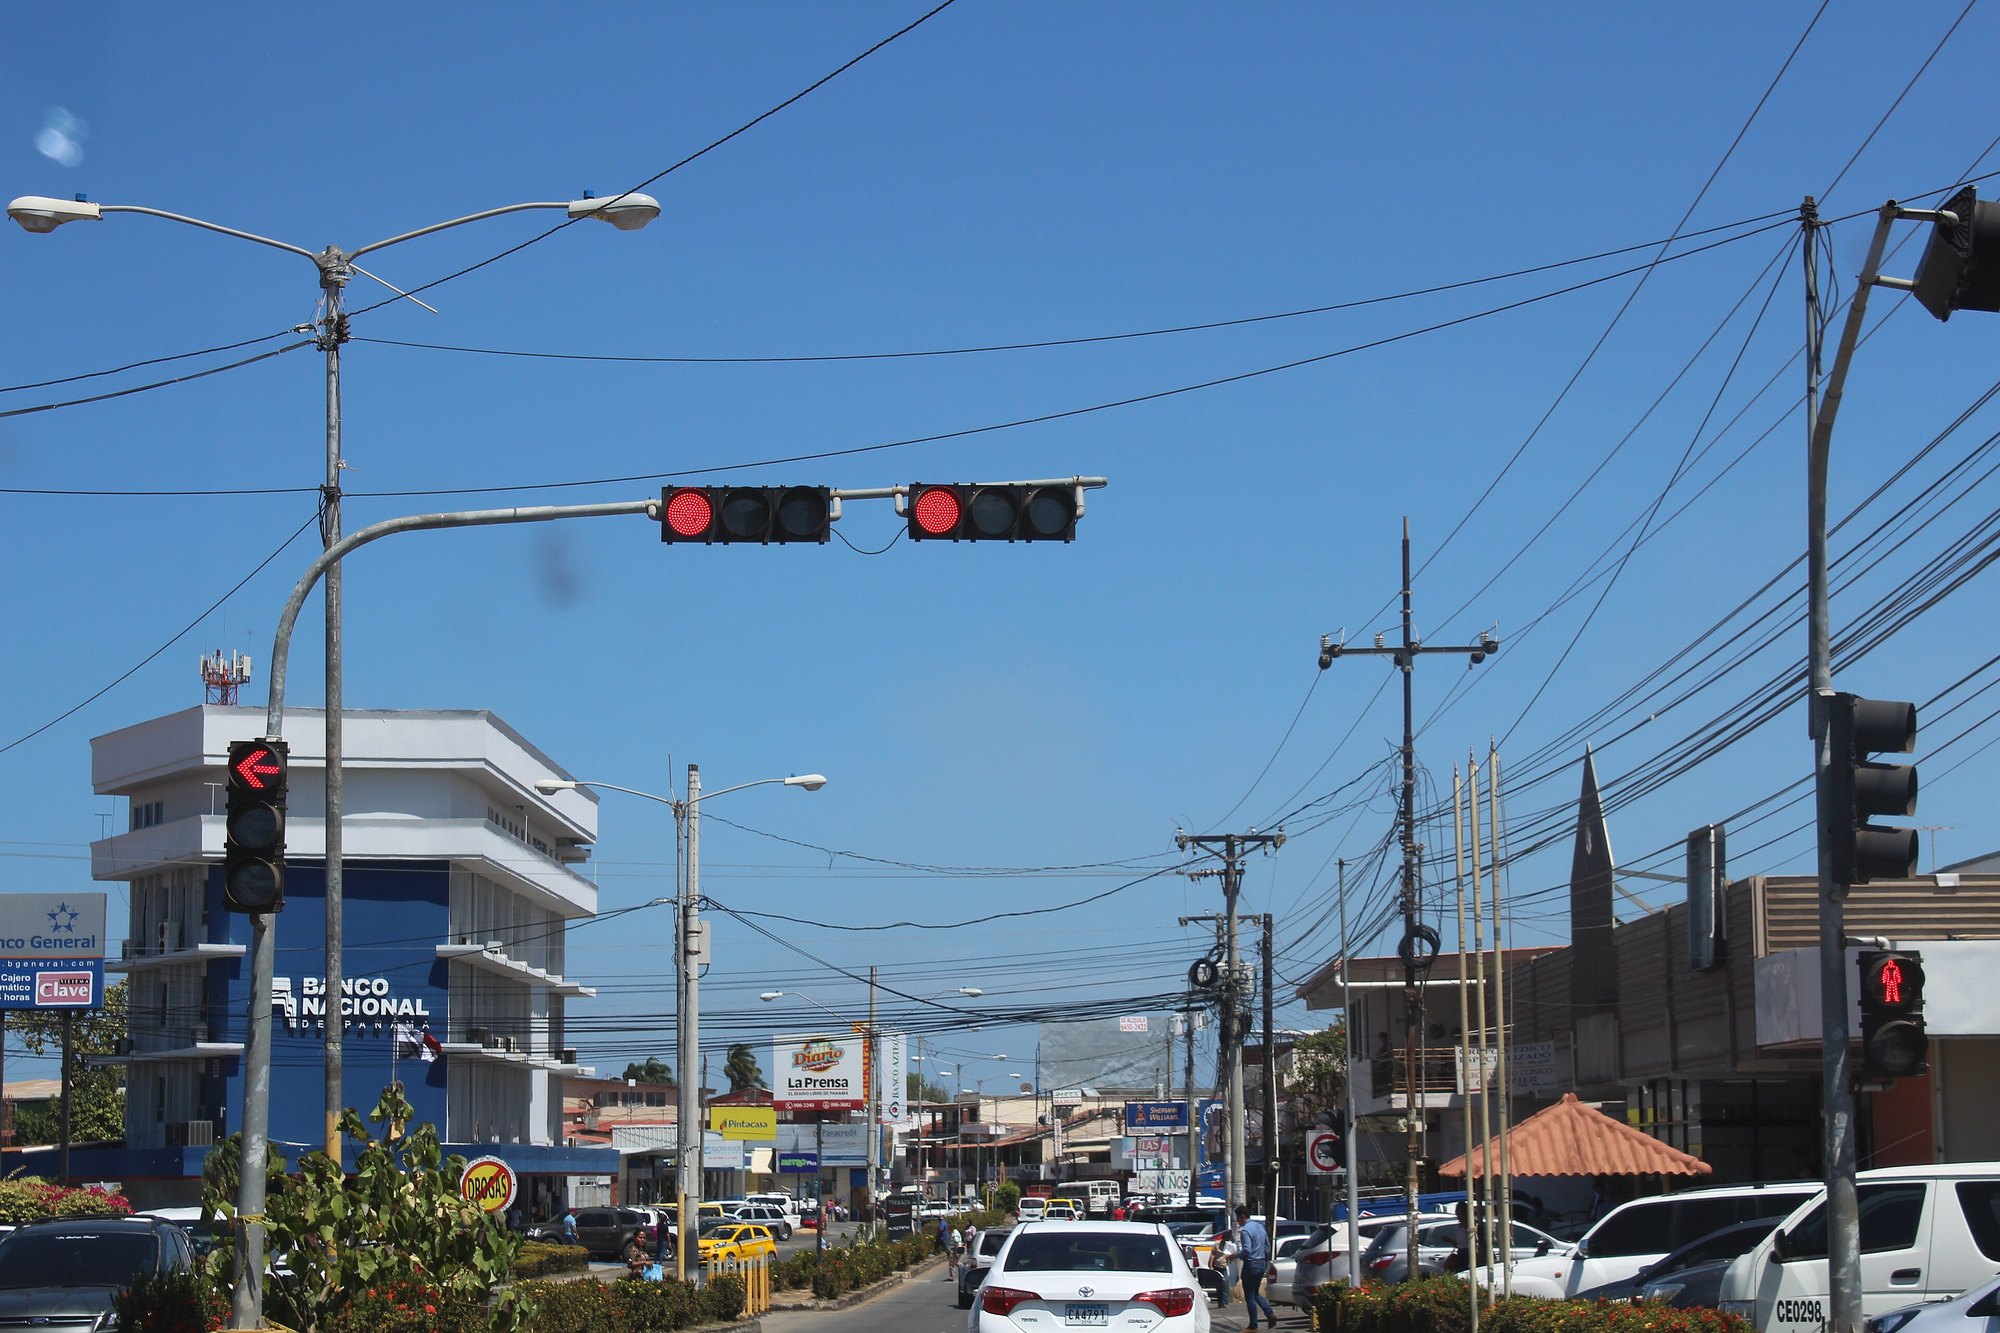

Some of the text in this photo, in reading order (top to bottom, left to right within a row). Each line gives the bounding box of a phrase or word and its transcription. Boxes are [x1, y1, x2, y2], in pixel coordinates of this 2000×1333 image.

[30, 935, 96, 949] General
[1, 974, 31, 983] Cajero
[39, 981, 89, 997] Clave
[4, 993, 30, 1001] horas
[302, 1020, 324, 1029] DE
[793, 1045, 843, 1067] Diario
[788, 1077, 849, 1088] La Prensa
[892, 1069, 900, 1099] BANCO
[728, 1120, 768, 1128] Pintacasa
[822, 1129, 857, 1137] Panacredit
[467, 1174, 507, 1200] DROGAS
[1068, 1309, 1105, 1320] CA4791
[1776, 1299, 1822, 1323] CE0298
